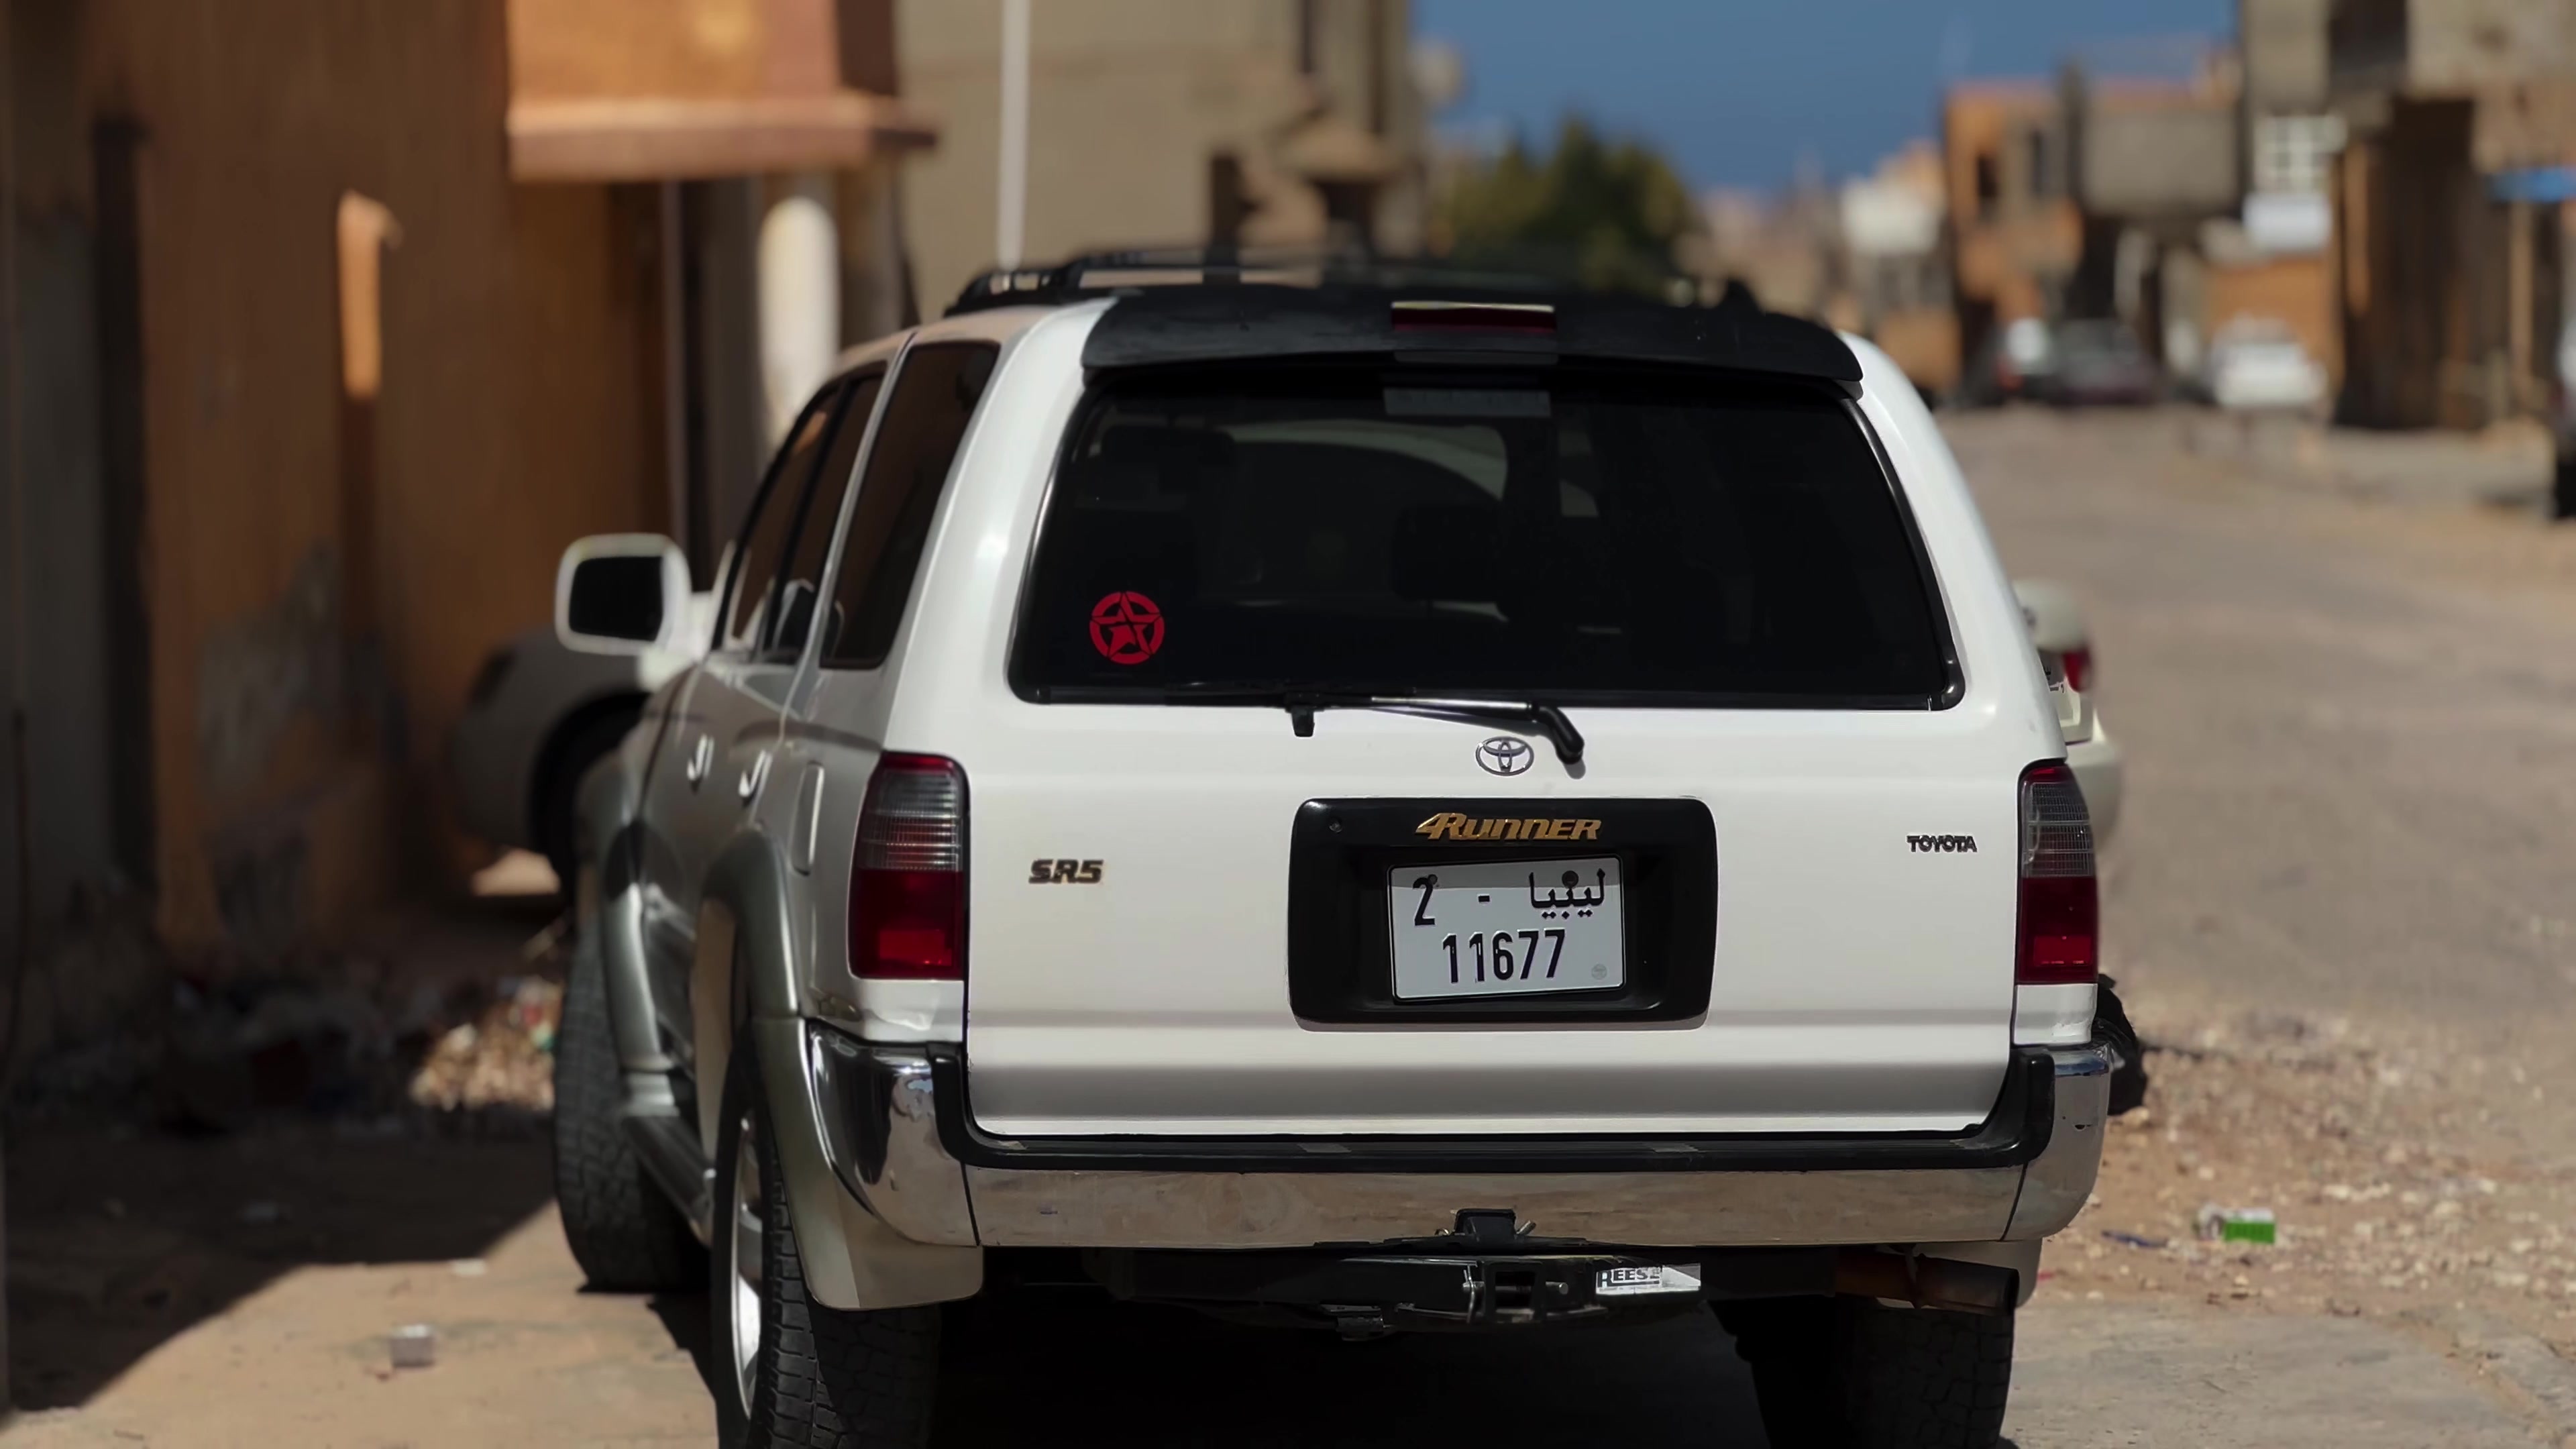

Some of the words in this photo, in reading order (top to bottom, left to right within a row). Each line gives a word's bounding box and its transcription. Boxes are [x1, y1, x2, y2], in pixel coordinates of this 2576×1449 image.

[1907, 835, 1978, 853] TOYOTA
[1028, 859, 1104, 884] SR5
[1529, 868, 1605, 919] ليبيا
[1413, 877, 1435, 926] 2
[1443, 928, 1565, 983] 11677
